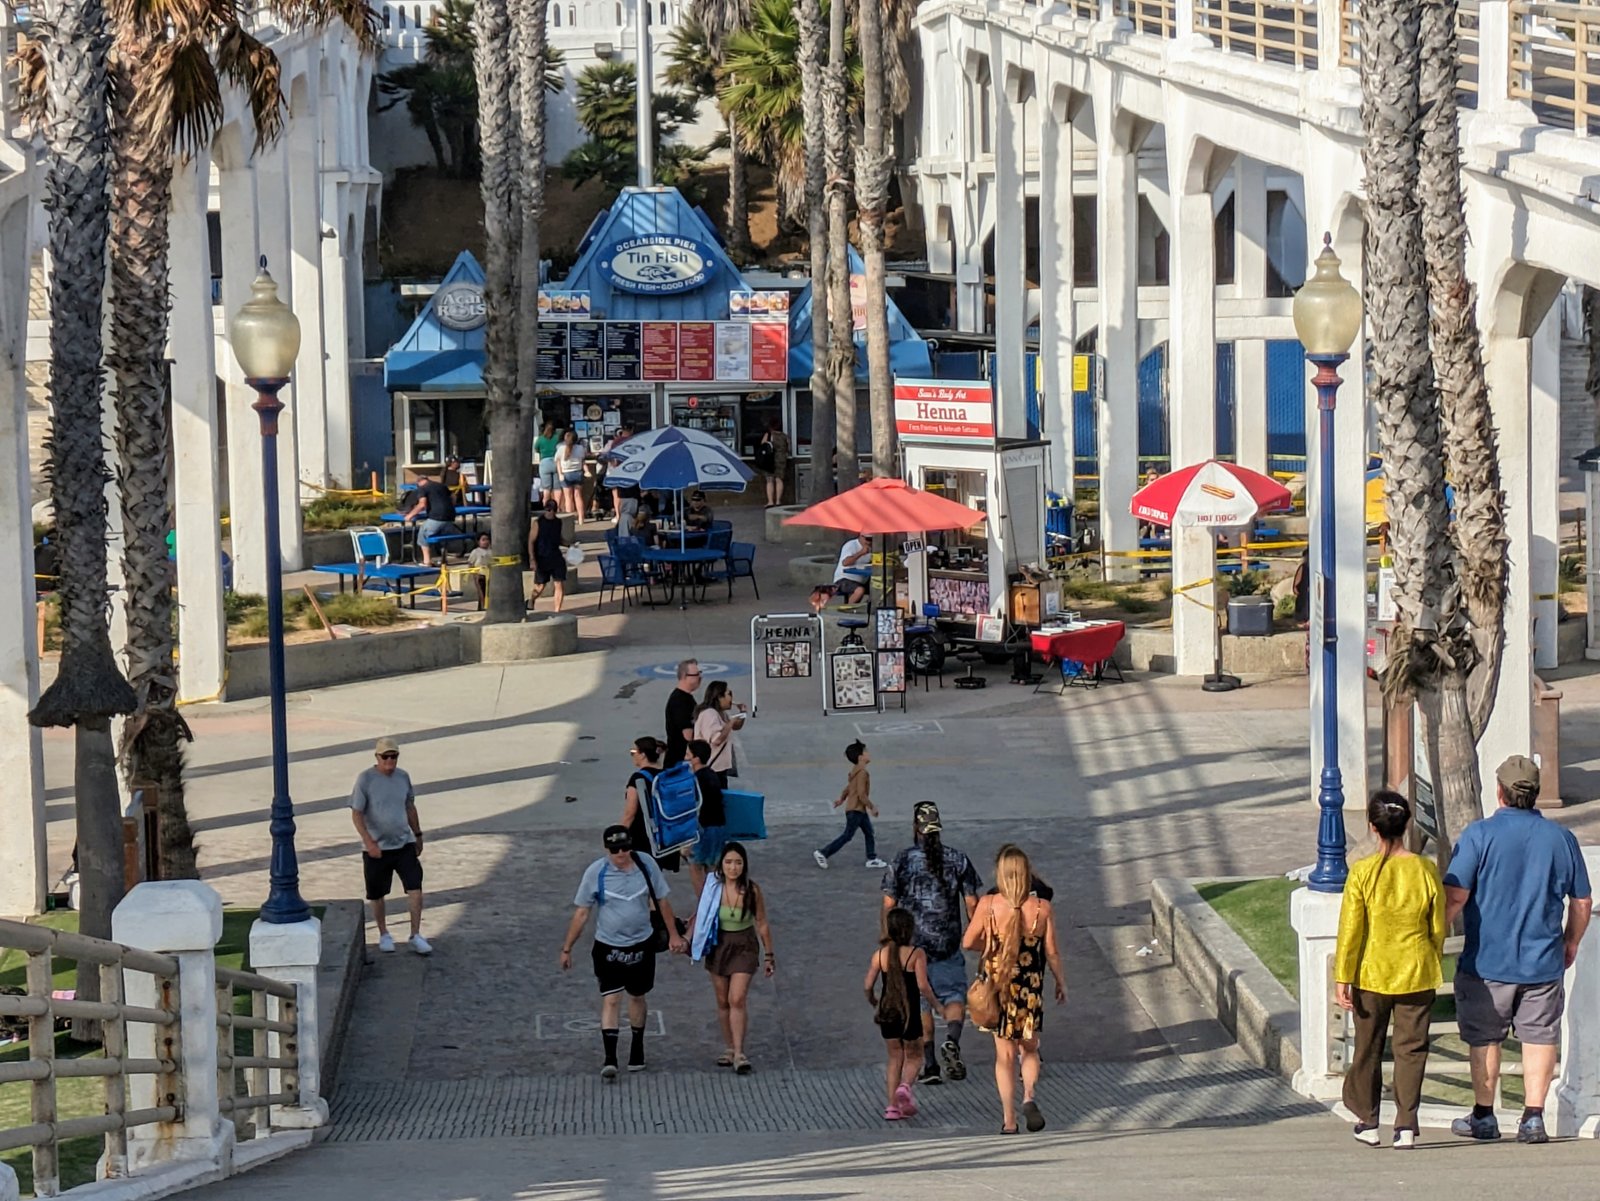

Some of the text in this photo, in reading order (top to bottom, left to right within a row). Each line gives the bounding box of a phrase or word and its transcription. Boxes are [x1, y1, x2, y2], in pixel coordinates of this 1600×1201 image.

[616, 237, 697, 252] OCEANSIDE PIER
[627, 252, 688, 264] Tin Fish
[611, 274, 636, 289] FRESH
[685, 273, 705, 287] FOOD
[916, 403, 967, 420] Henna
[1215, 514, 1237, 522] DOGS
[905, 540, 922, 551] OPEN
[765, 627, 810, 638] HENNA
